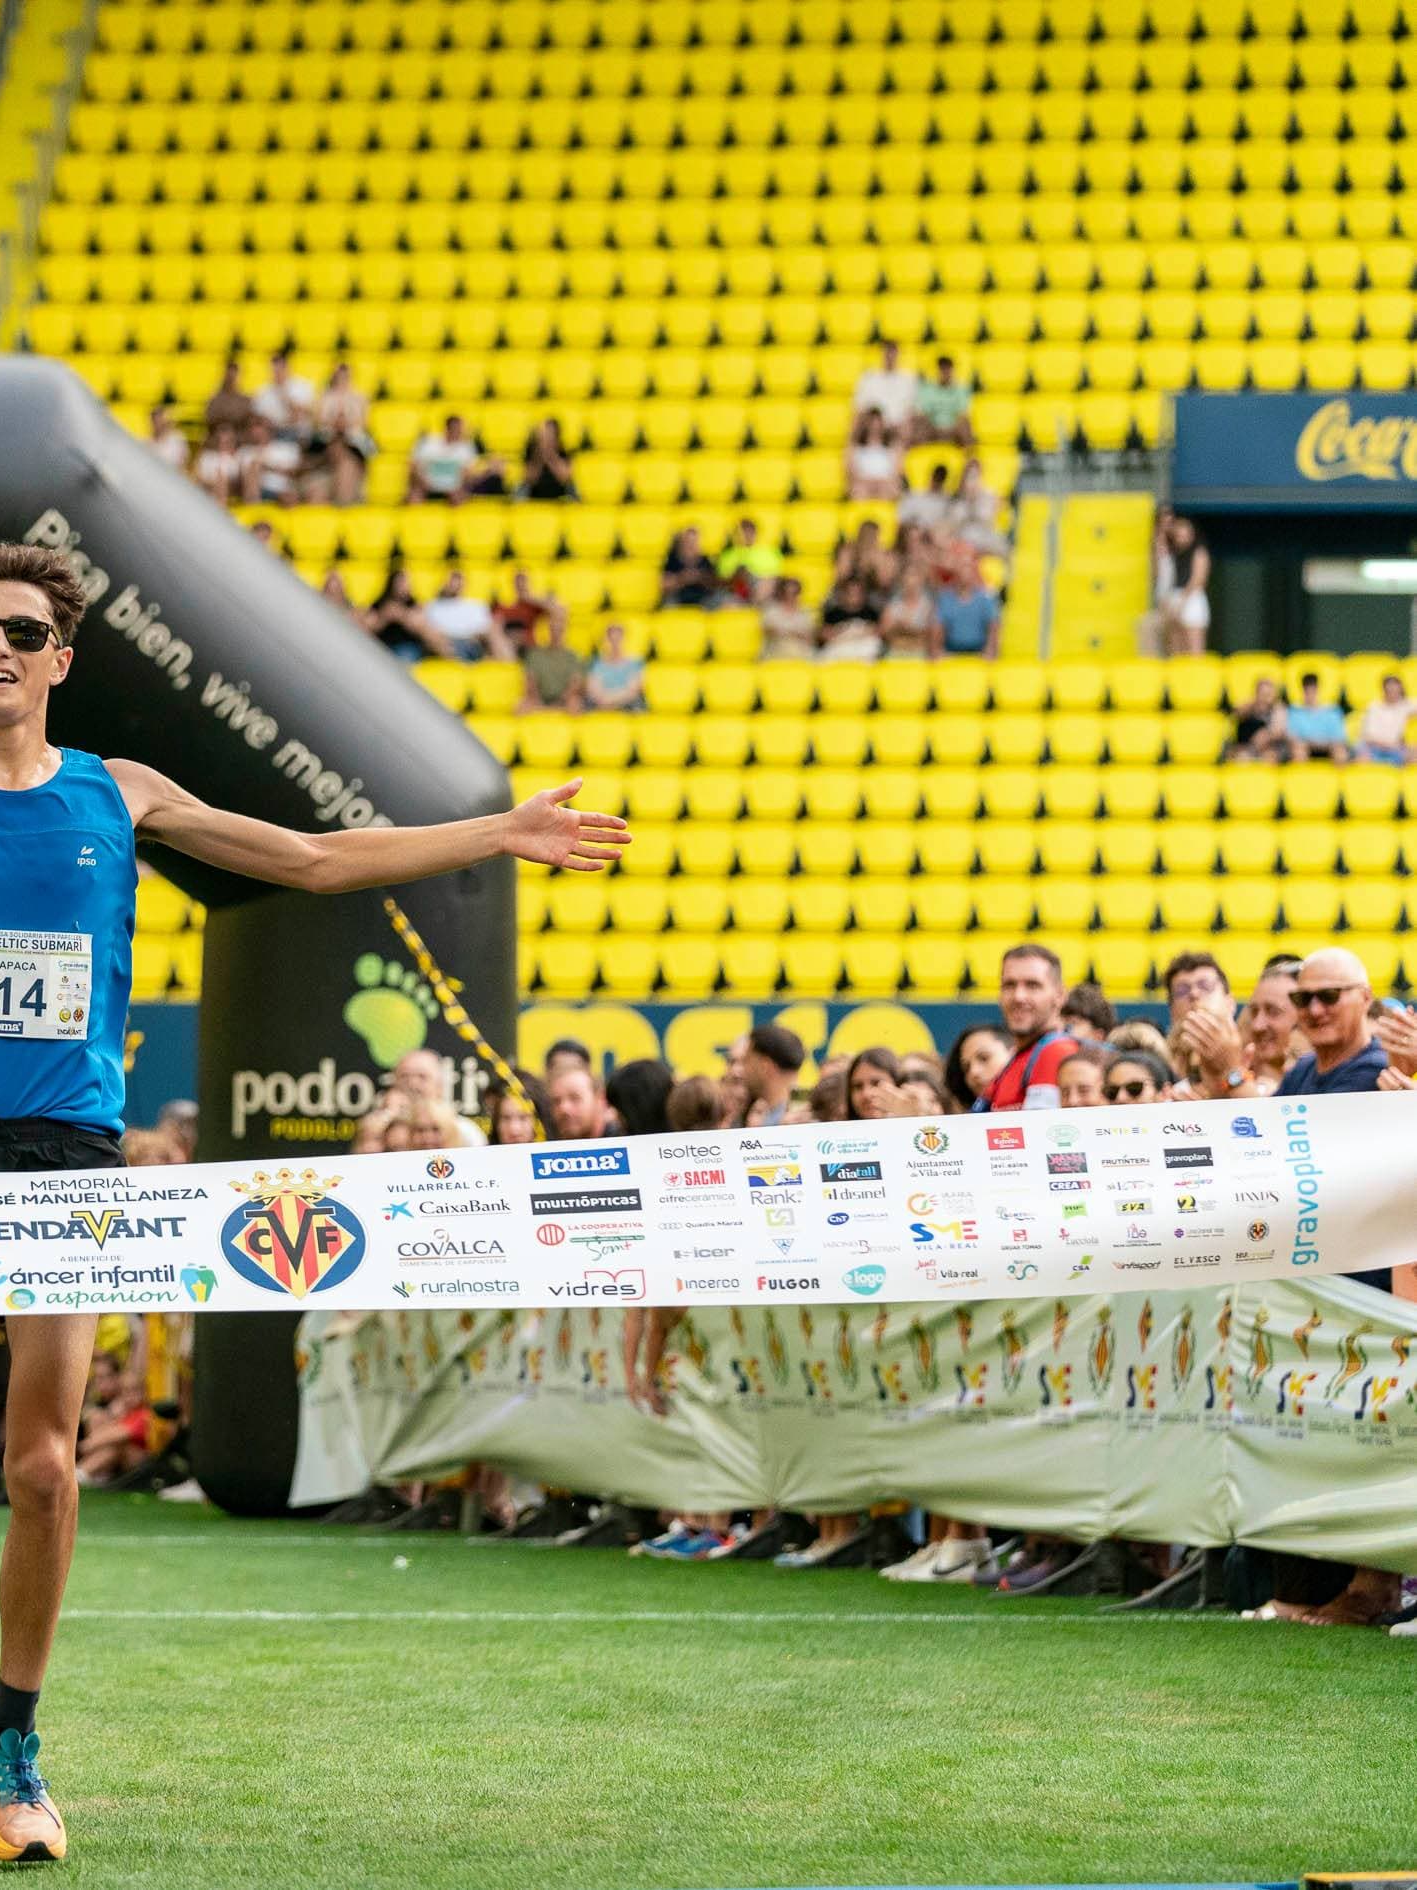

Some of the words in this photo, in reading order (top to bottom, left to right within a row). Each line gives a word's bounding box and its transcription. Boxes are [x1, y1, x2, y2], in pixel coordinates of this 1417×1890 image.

[102, 584, 193, 690] bien,
[201, 672, 279, 750] vive
[658, 1145, 721, 1160] Isoltec
[906, 1159, 964, 1169] Ajuntament
[684, 1169, 726, 1186] SACMI
[919, 1168, 961, 1178] Vila-real
[30, 1177, 137, 1191] MEMORIAL
[387, 1180, 471, 1193] VILLARREAL
[475, 1180, 500, 1189] C.F.
[22, 1193, 108, 1206] MANUEL
[114, 1188, 209, 1202] LLANEZA
[419, 1199, 511, 1215] CaixaBank
[909, 1220, 979, 1243] SME
[398, 1240, 505, 1257] COVALCA
[91, 1264, 175, 1289] infantil
[685, 1278, 740, 1289] incerco
[757, 1276, 820, 1291] FULGOR
[421, 1279, 520, 1294] ruralnostra
[548, 1281, 637, 1297] vidres
[45, 1287, 180, 1309] aspanion
